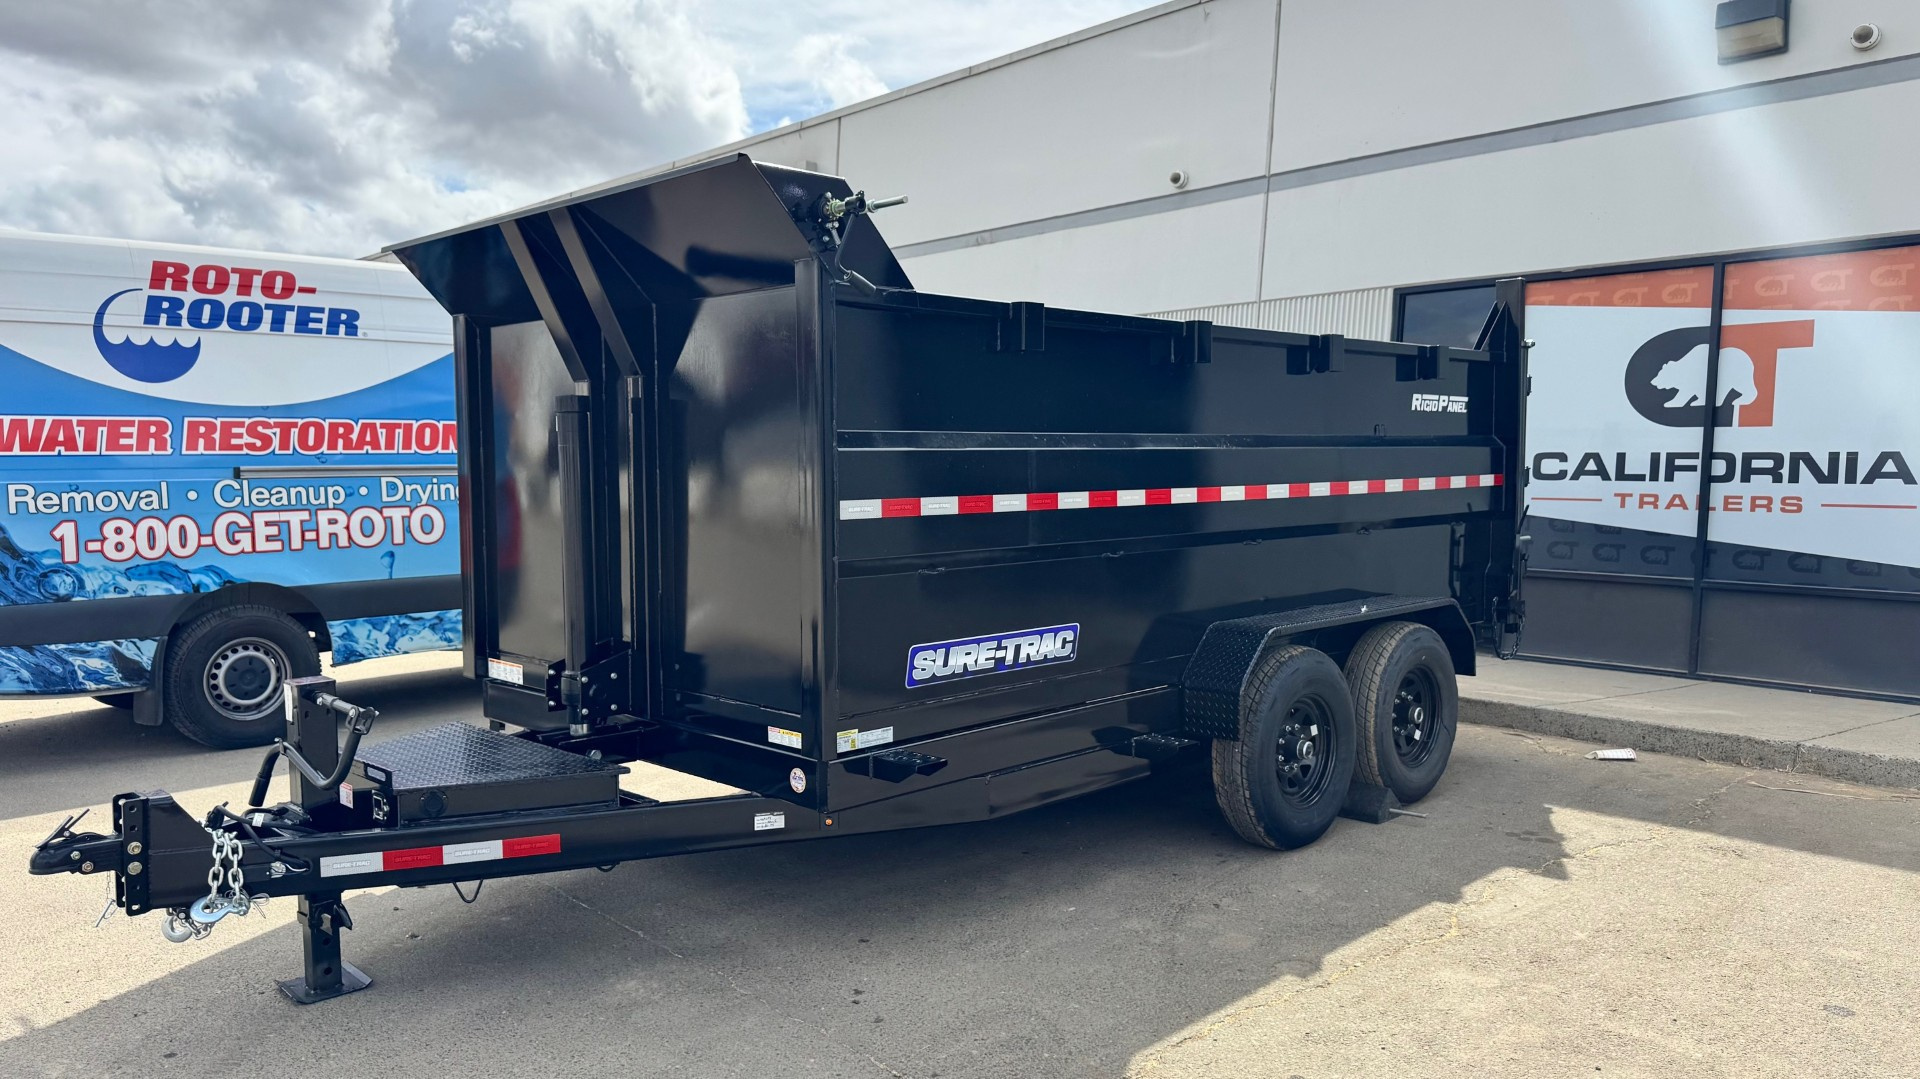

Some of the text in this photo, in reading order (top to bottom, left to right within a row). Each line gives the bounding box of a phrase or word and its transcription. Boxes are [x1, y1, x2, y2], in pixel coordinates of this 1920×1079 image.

[149, 260, 317, 300] ROTO-
[143, 295, 360, 337] ROOTER
[0, 417, 457, 454] WATER RESTORATION
[1531, 451, 1918, 485] CALIFORNIA
[7, 476, 459, 514] Removal Cleanup Dryin
[50, 504, 445, 564] 1-800-GET-ROTO
[912, 630, 1073, 680] SURE-TRAC
